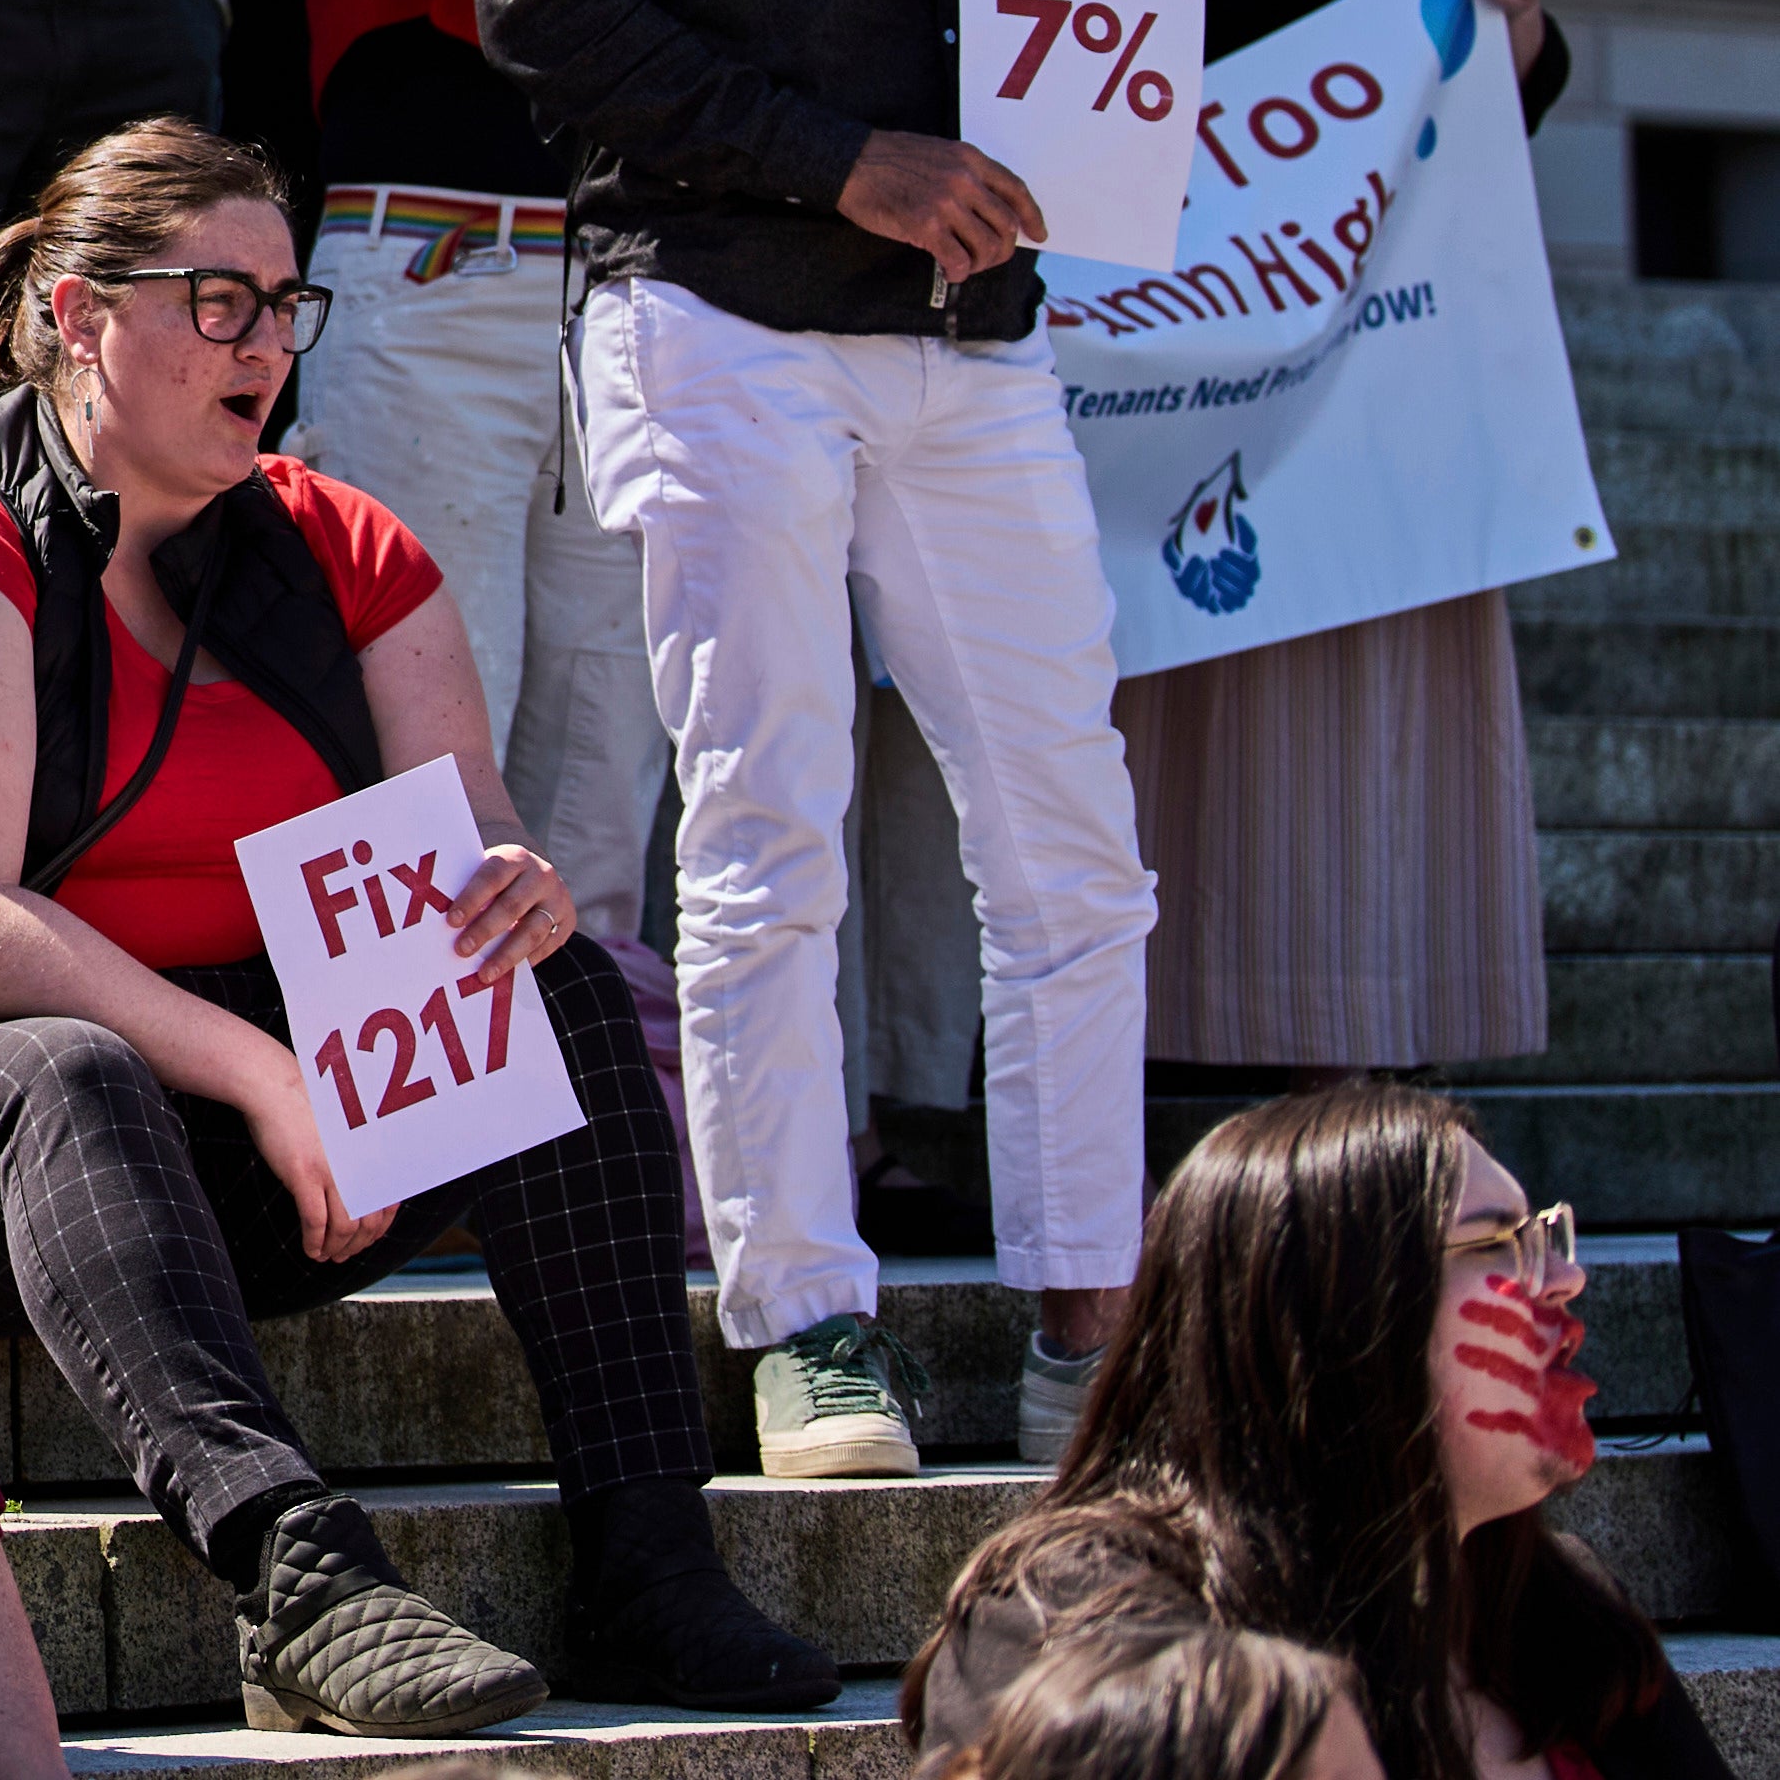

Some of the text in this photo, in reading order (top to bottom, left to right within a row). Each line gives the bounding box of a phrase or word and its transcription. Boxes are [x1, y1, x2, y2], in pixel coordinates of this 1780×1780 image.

[1196, 61, 1384, 188] Too
[1349, 280, 1438, 335] OW!
[1064, 380, 1186, 419] Tenants
[1188, 365, 1270, 409] Need
[300, 838, 452, 959] Fix
[315, 970, 516, 1131] 1217
